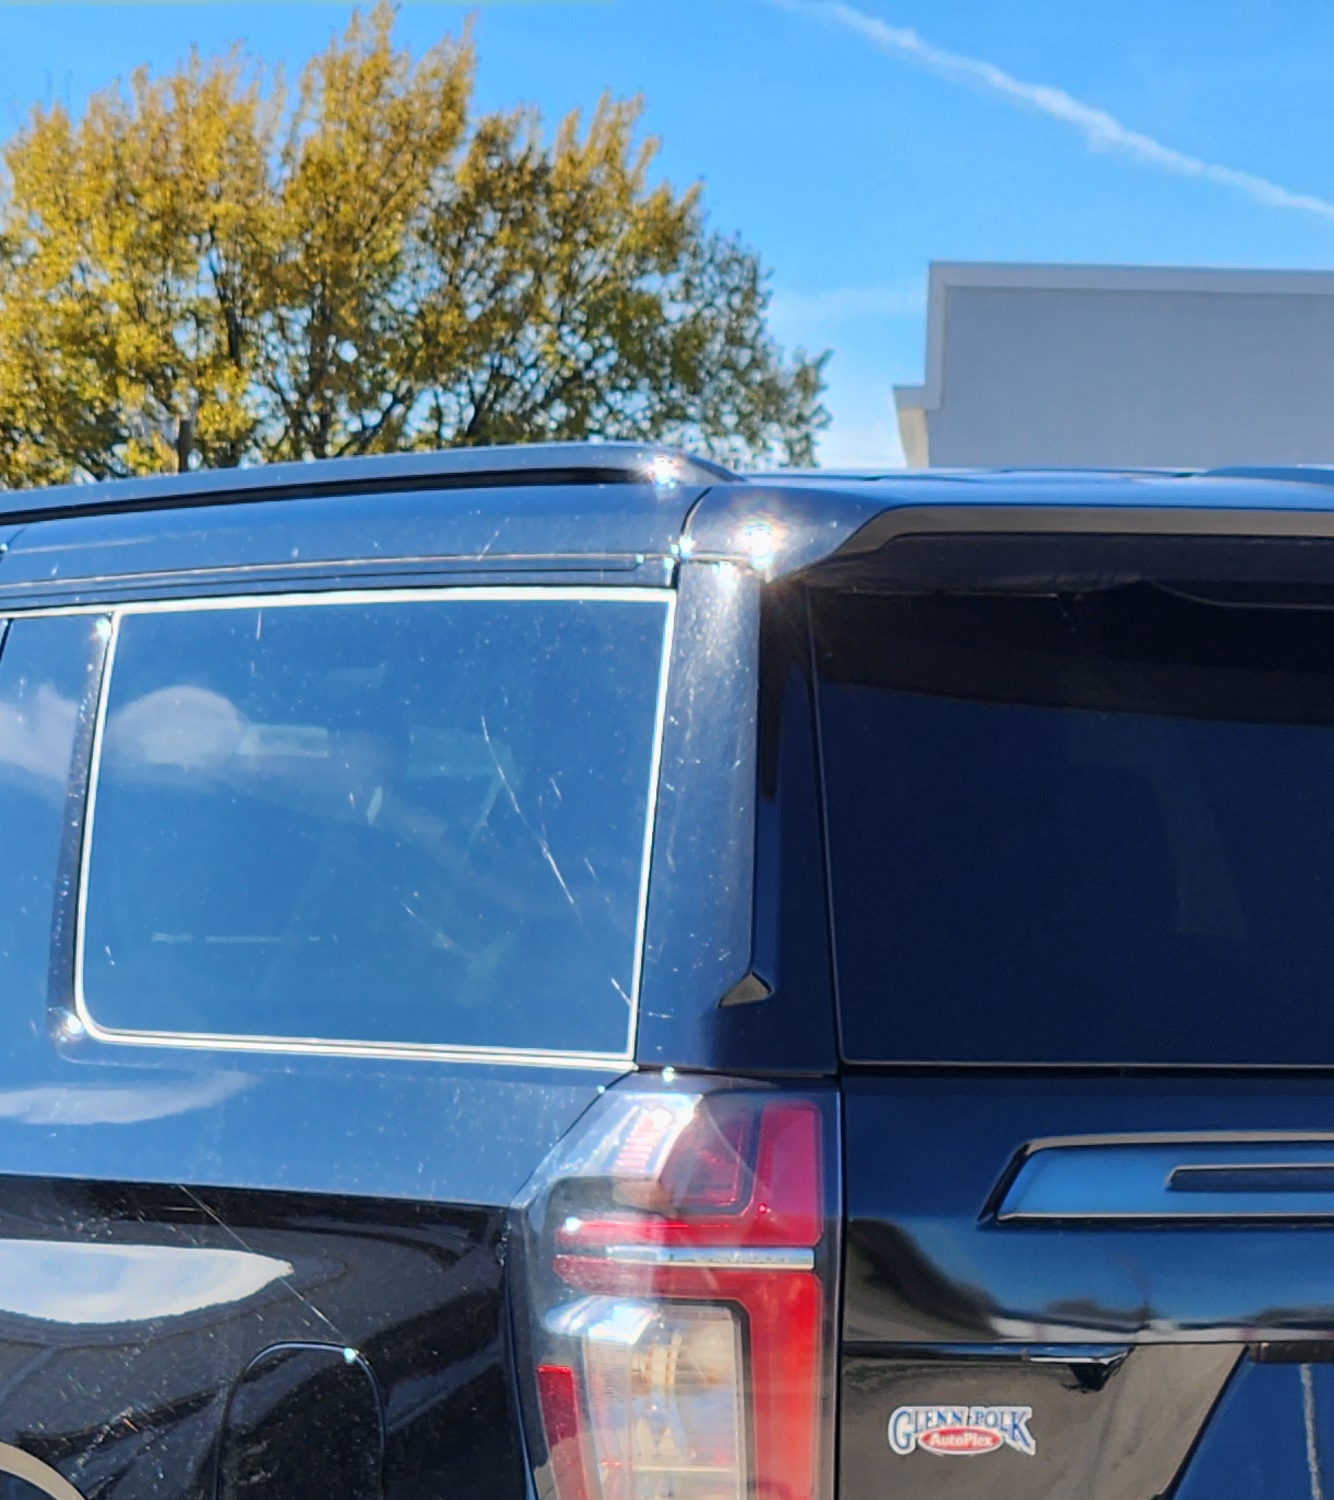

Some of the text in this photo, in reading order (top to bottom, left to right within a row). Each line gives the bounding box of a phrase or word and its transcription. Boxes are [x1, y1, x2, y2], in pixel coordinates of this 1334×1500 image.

[892, 1410, 1031, 1450] GLENN POLK
[929, 1432, 993, 1447] AutoPlex
